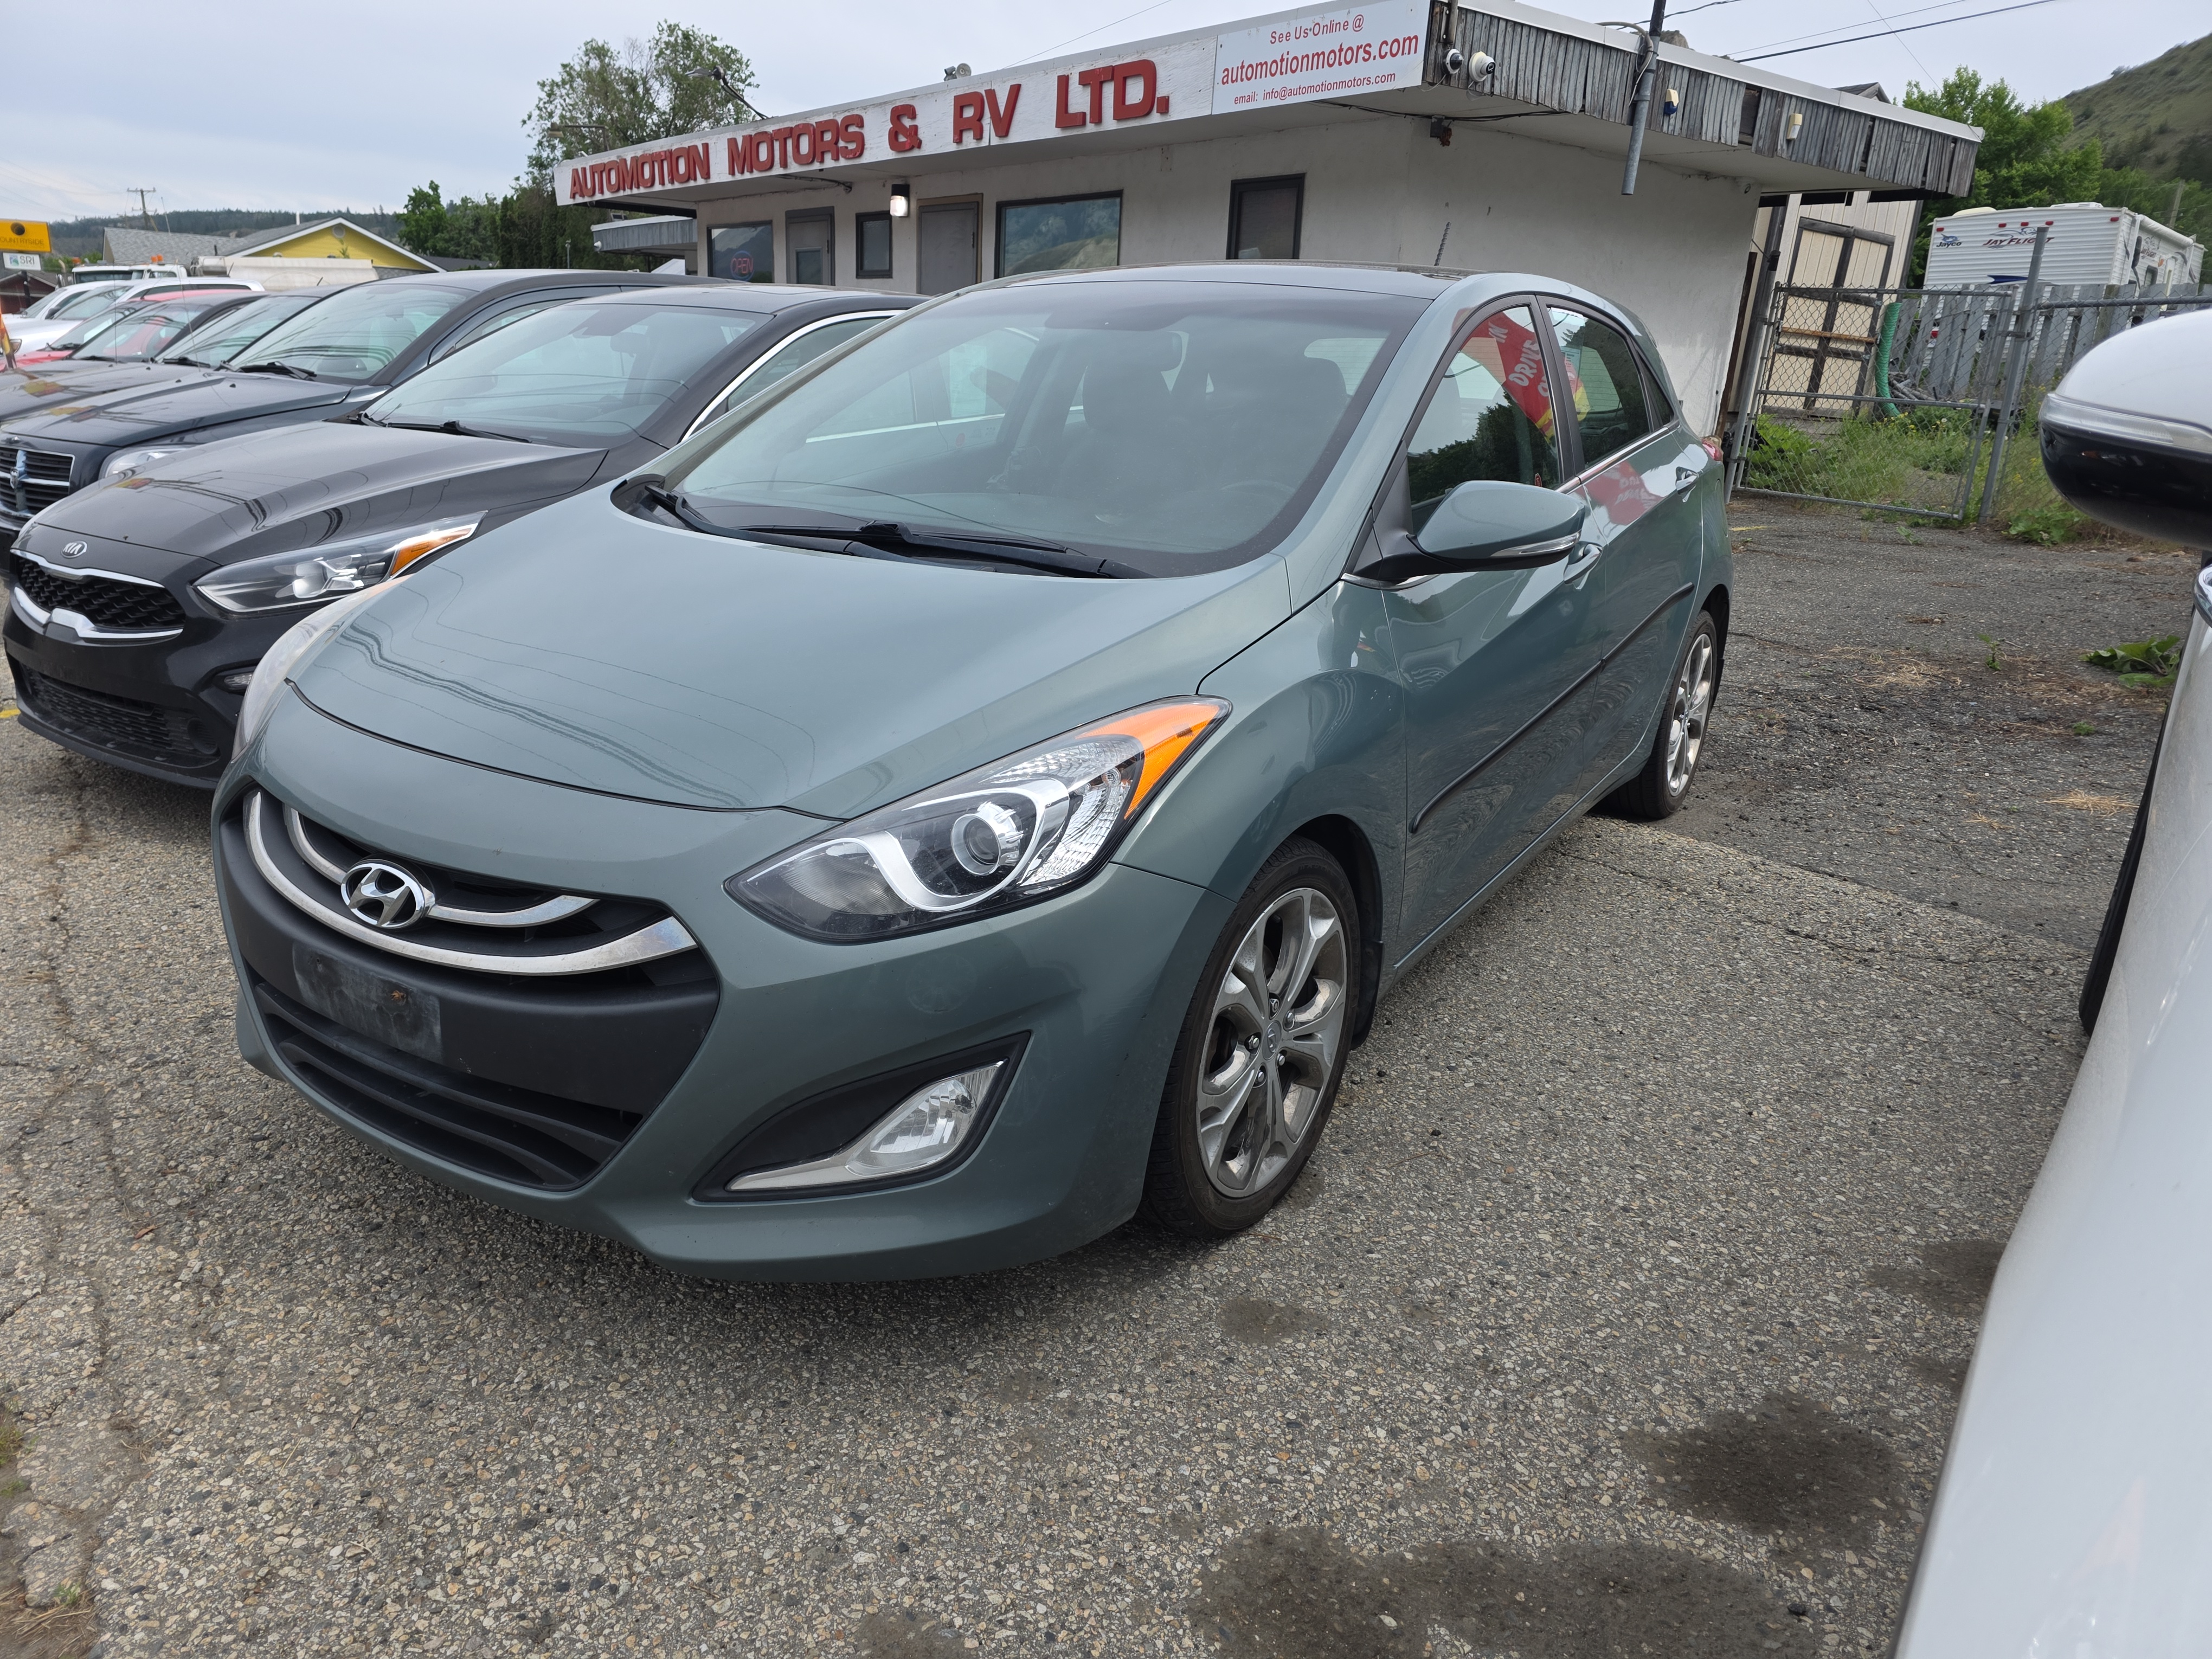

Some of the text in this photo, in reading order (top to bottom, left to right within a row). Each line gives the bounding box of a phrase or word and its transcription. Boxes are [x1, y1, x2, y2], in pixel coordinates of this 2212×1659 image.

[1270, 14, 1364, 44] See Us Online @
[1221, 34, 1419, 85] automotionmotors.com
[1234, 72, 1396, 105] email: info@automotionmotors.com
[570, 59, 1169, 199] AUTOMOTION MOTORS & RV LTD.
[2007, 237, 2055, 245] FLIGT
[20, 255, 35, 265] SRI
[731, 258, 753, 274] OPEN
[63, 542, 82, 555] KIA
